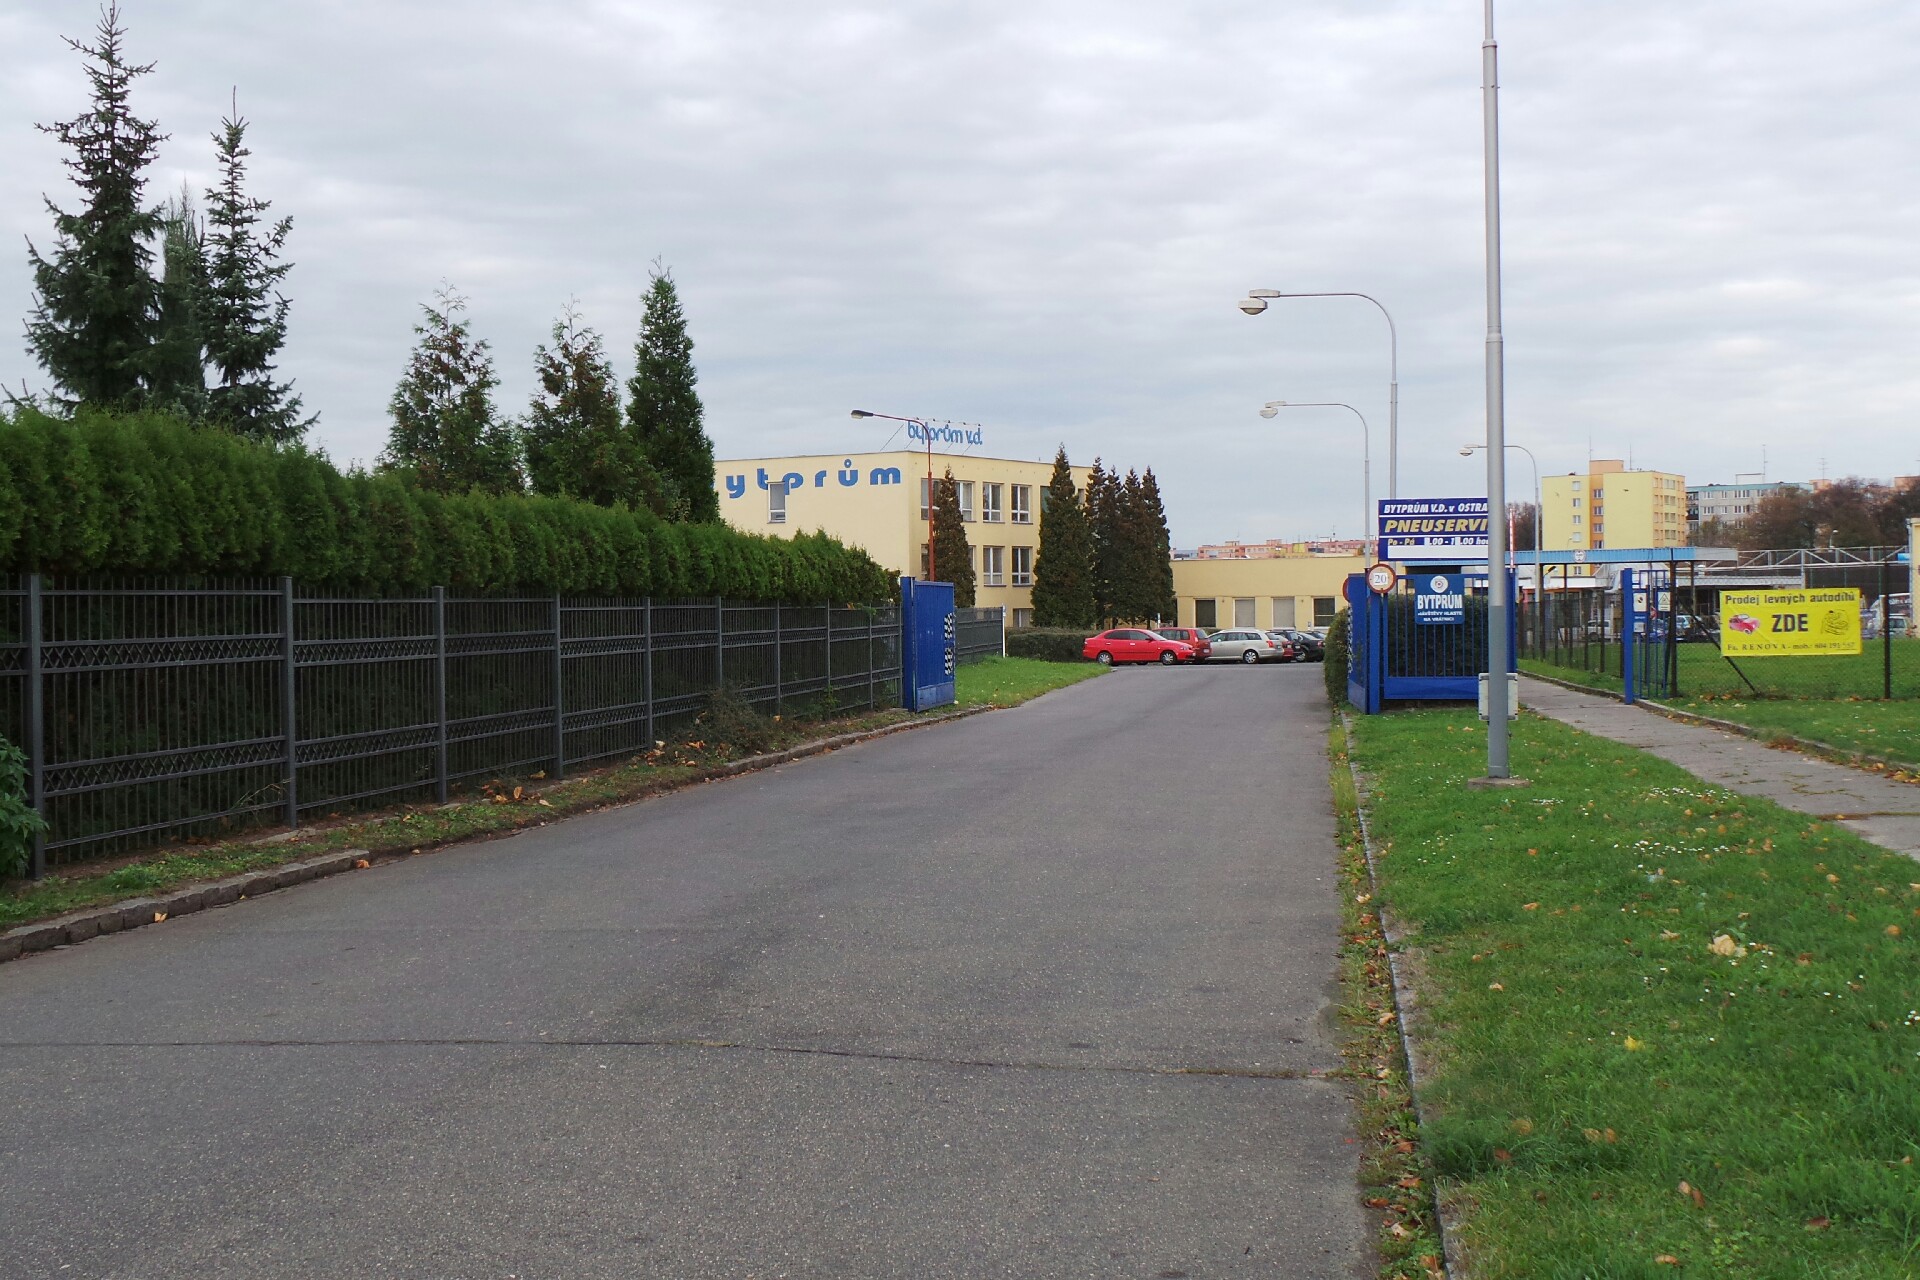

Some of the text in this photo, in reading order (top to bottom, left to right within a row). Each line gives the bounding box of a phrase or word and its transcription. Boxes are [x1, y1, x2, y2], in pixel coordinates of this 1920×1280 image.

[709, 459, 901, 499] ytprům
[1431, 503, 1447, 513] V.D.
[1458, 502, 1488, 512] OSTRA
[1384, 519, 1488, 533] PNEUSERVI
[1388, 538, 1398, 546] Po
[1450, 537, 1474, 545] 1.00
[1375, 574, 1387, 584] 20
[1725, 591, 1855, 606] Prodej levných autodílů
[1771, 613, 1809, 633] ZDE
